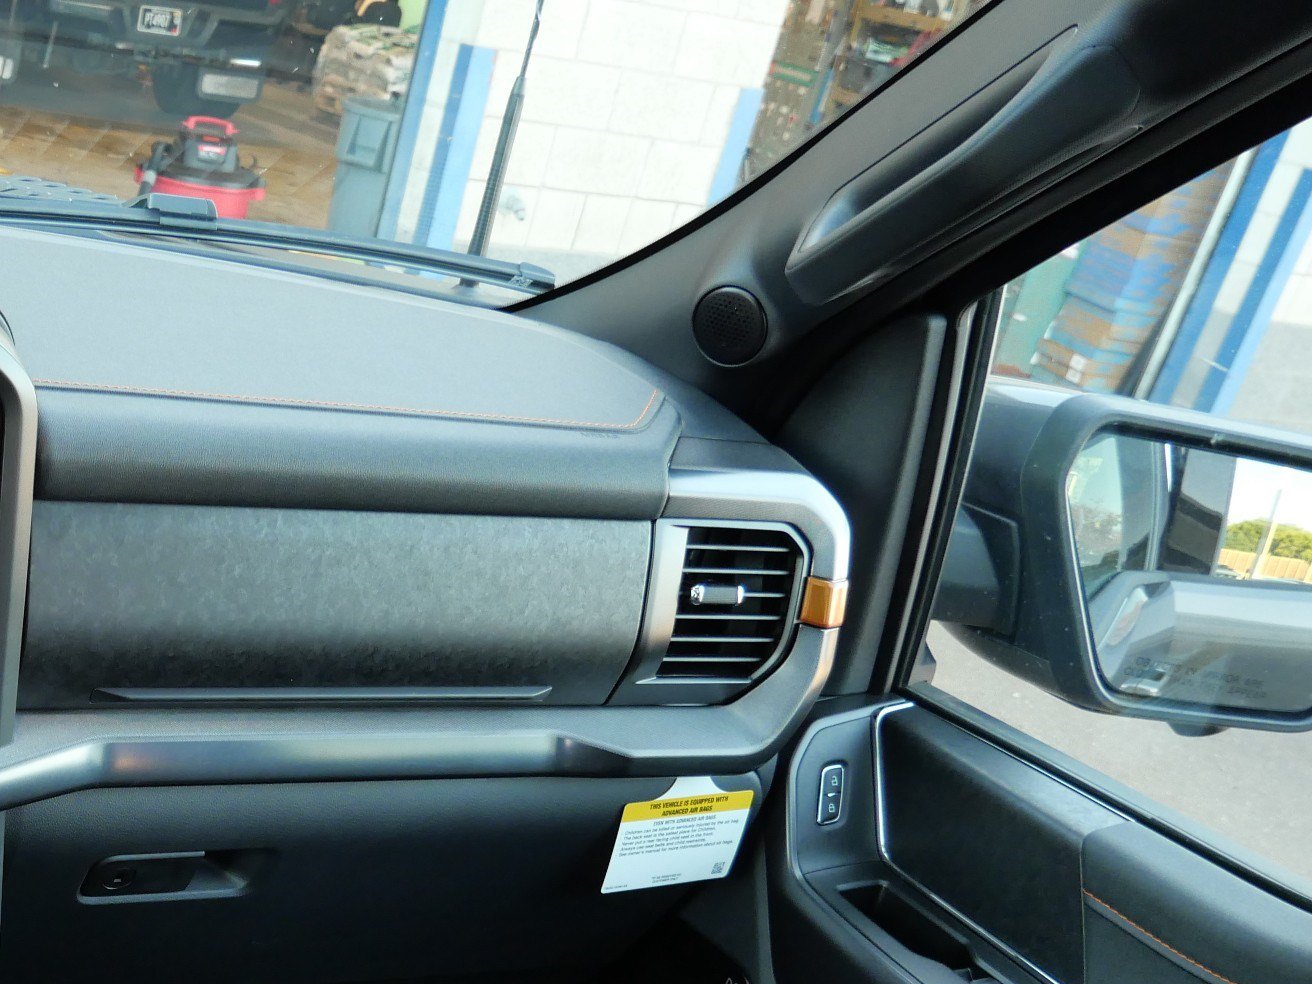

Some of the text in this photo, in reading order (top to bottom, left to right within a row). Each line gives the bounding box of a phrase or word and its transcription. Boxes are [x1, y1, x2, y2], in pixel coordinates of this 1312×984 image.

[663, 801, 683, 809] VEHICLE
[690, 798, 714, 806] EQUIPPED
[661, 809, 688, 817] ADVANCED
